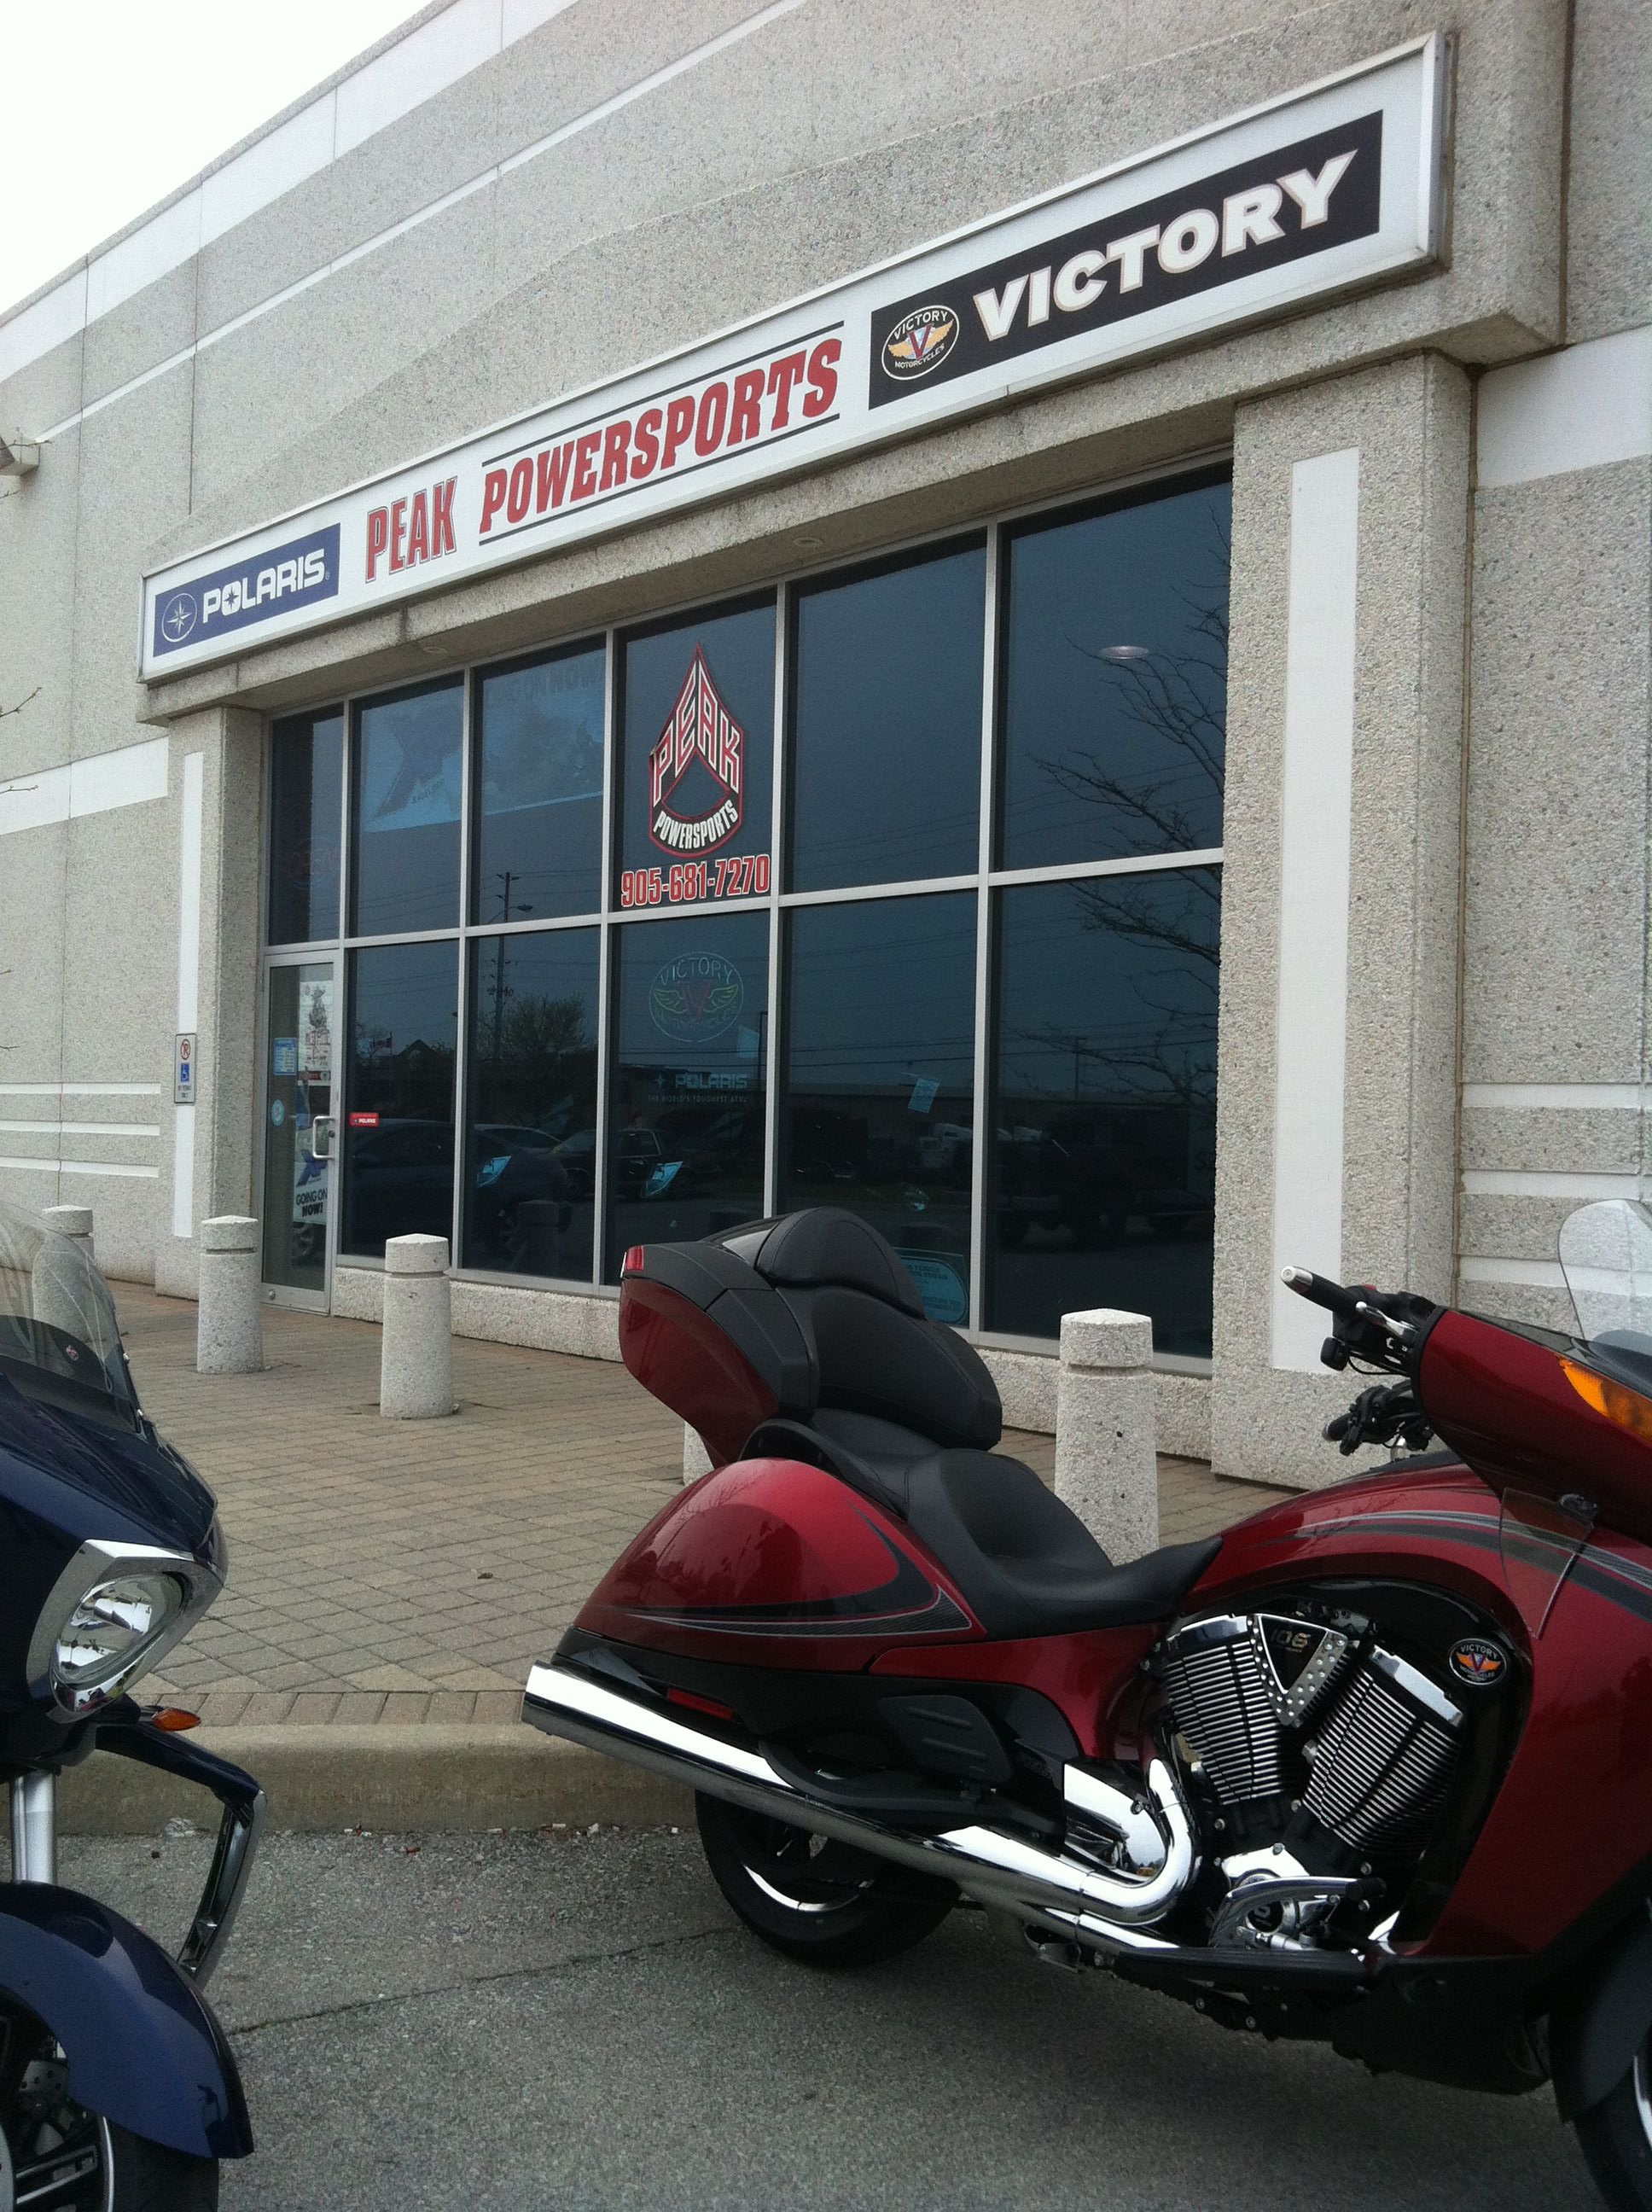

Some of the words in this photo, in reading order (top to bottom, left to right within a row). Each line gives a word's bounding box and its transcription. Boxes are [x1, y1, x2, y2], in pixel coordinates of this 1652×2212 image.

[973, 148, 1358, 341] VICTORY
[893, 310, 948, 341] VICTORY
[894, 342, 945, 369] MOTORCYCLES
[365, 476, 457, 584] PEAK
[479, 338, 842, 534] POWERSPORTS
[202, 548, 325, 624] POLARIS
[653, 660, 740, 808] PEAK
[653, 799, 739, 850] POWERSPORTS
[620, 854, 771, 908] 905-681-7270
[660, 956, 734, 986] VICTORY
[675, 1073, 747, 1089] POLARIS
[295, 1190, 317, 1206] GOING
[317, 1187, 329, 1202] ON
[301, 1201, 323, 1218] NOW!
[1460, 1644, 1499, 1661] VICTORY
